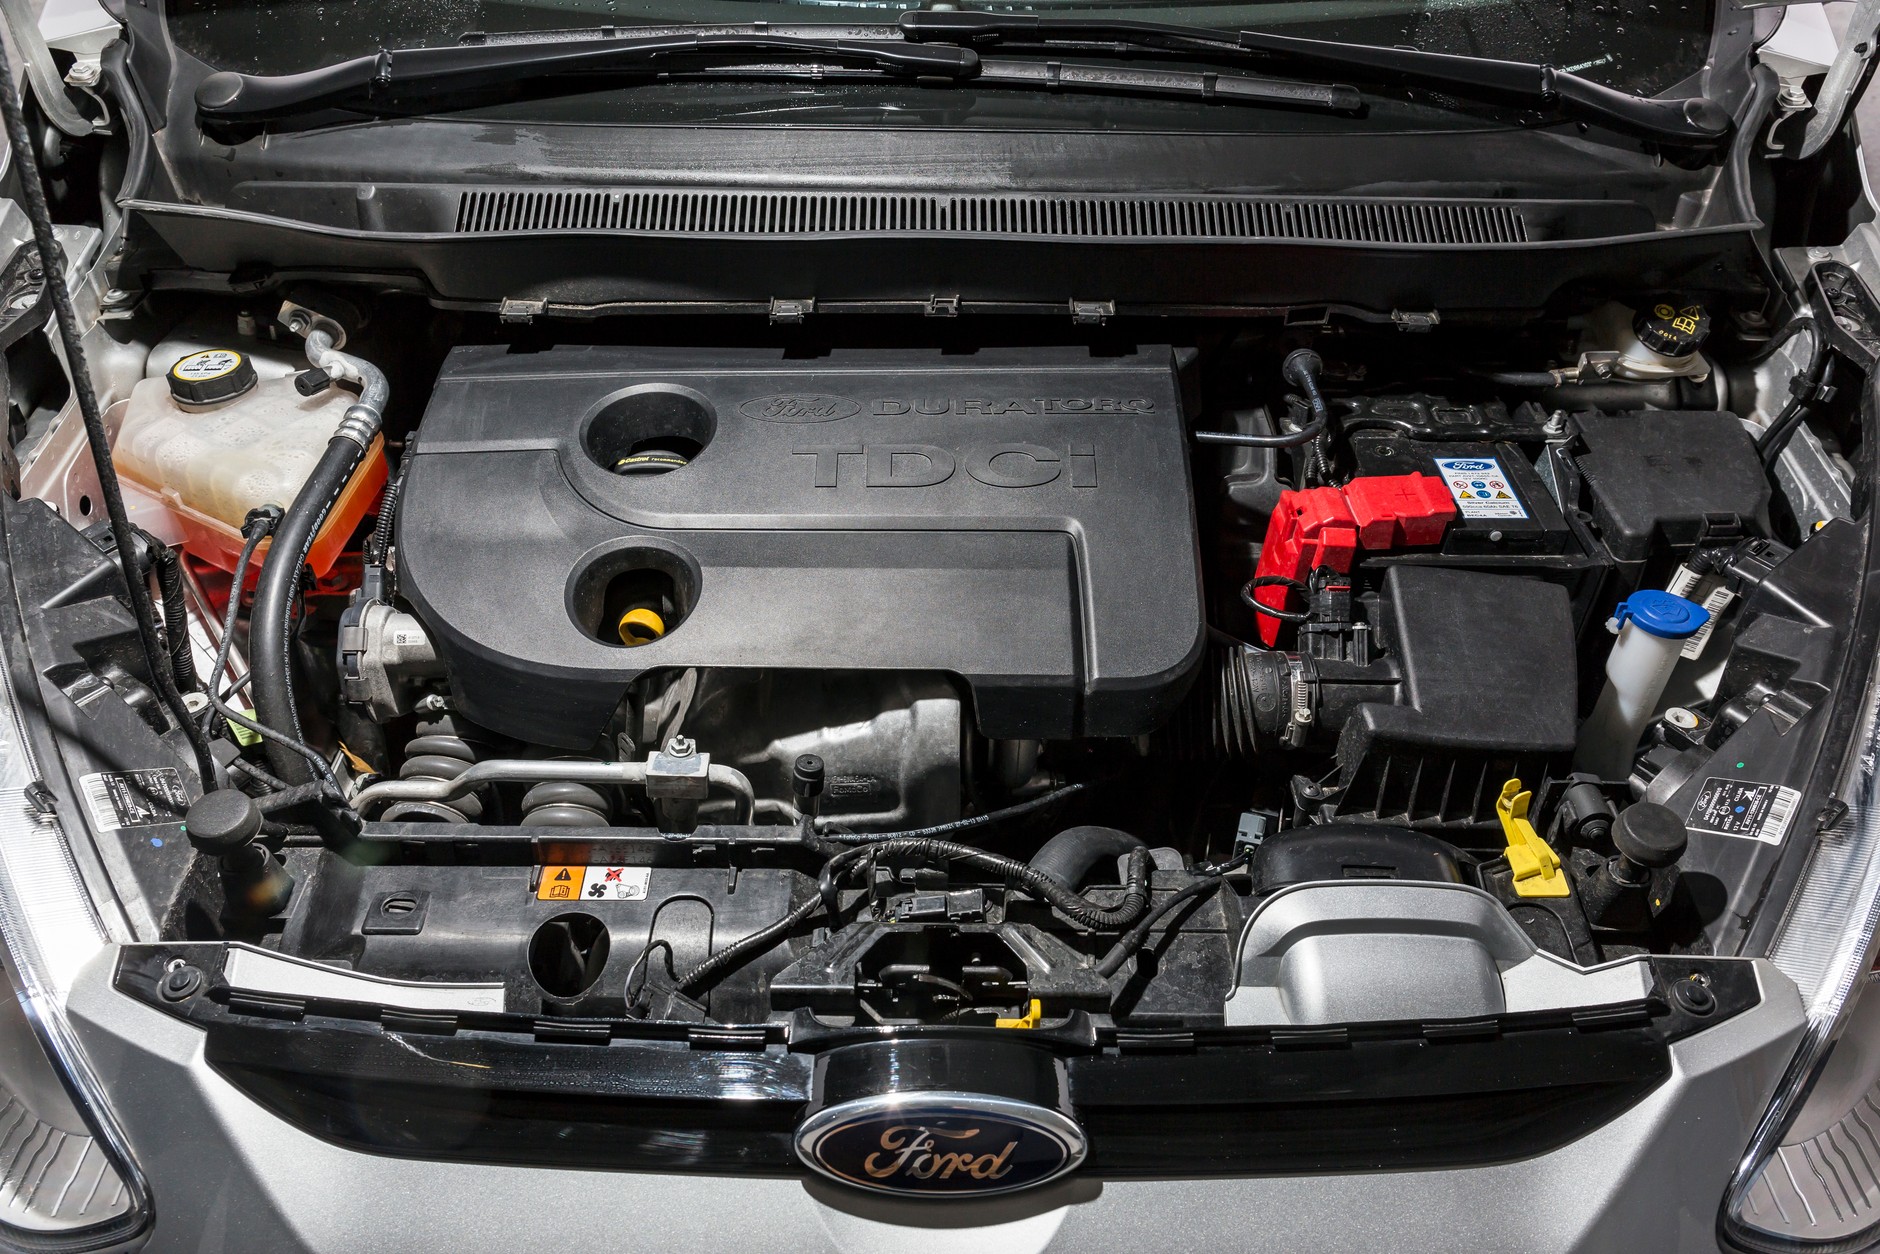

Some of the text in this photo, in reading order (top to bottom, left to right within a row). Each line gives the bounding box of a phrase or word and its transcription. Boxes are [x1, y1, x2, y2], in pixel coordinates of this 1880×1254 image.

[761, 398, 1156, 418] Ford DURATORQ
[792, 443, 1098, 488] TDCi
[1452, 461, 1485, 471] Ford
[864, 1124, 1018, 1179] Ford
